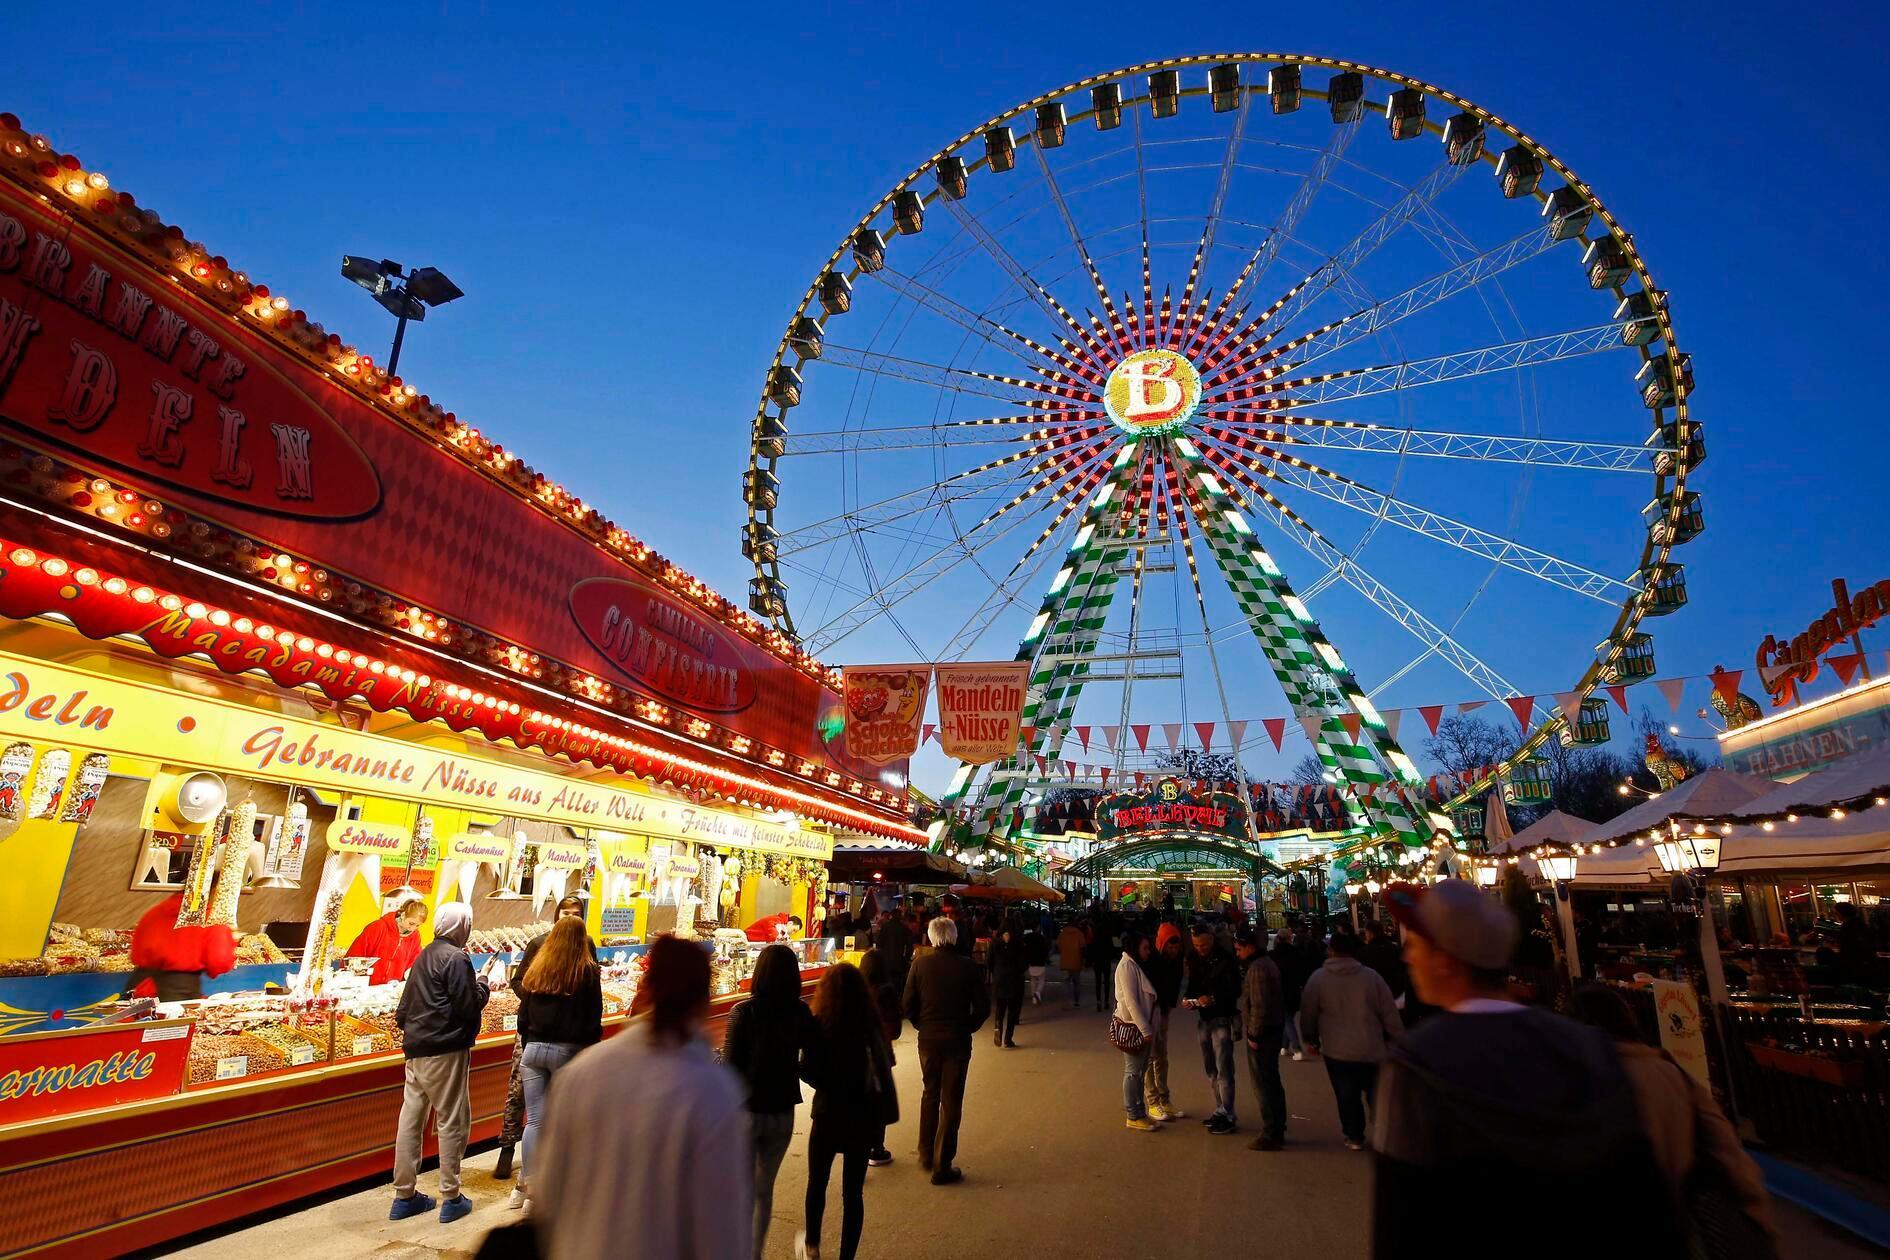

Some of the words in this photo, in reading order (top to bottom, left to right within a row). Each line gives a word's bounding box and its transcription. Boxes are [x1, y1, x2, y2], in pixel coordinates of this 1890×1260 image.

[1118, 357, 1185, 423] B
[946, 674, 974, 683] Frisch
[973, 674, 1020, 686] gebrannte
[134, 609, 377, 693] Macadamia
[391, 680, 475, 720] Nüsse
[519, 718, 637, 768] Cashewkerne
[658, 761, 715, 789] Mandeln
[942, 684, 1020, 712] Mandeln
[241, 725, 415, 784] Gebrannte
[421, 760, 498, 799] Nüsse
[507, 785, 544, 806] aus
[546, 785, 600, 814] Aller
[605, 795, 646, 823] Welt
[1161, 782, 1178, 801] B
[681, 808, 727, 834] Früchte
[732, 825, 748, 839] mit
[1115, 804, 1227, 828] BELLEVUE
[339, 826, 400, 849] Erdnüsse
[454, 841, 505, 857] Cashewnüsse
[542, 848, 582, 864] Mandeln
[612, 855, 646, 869] Walnüsse
[0, 1049, 157, 1101] erwatte
